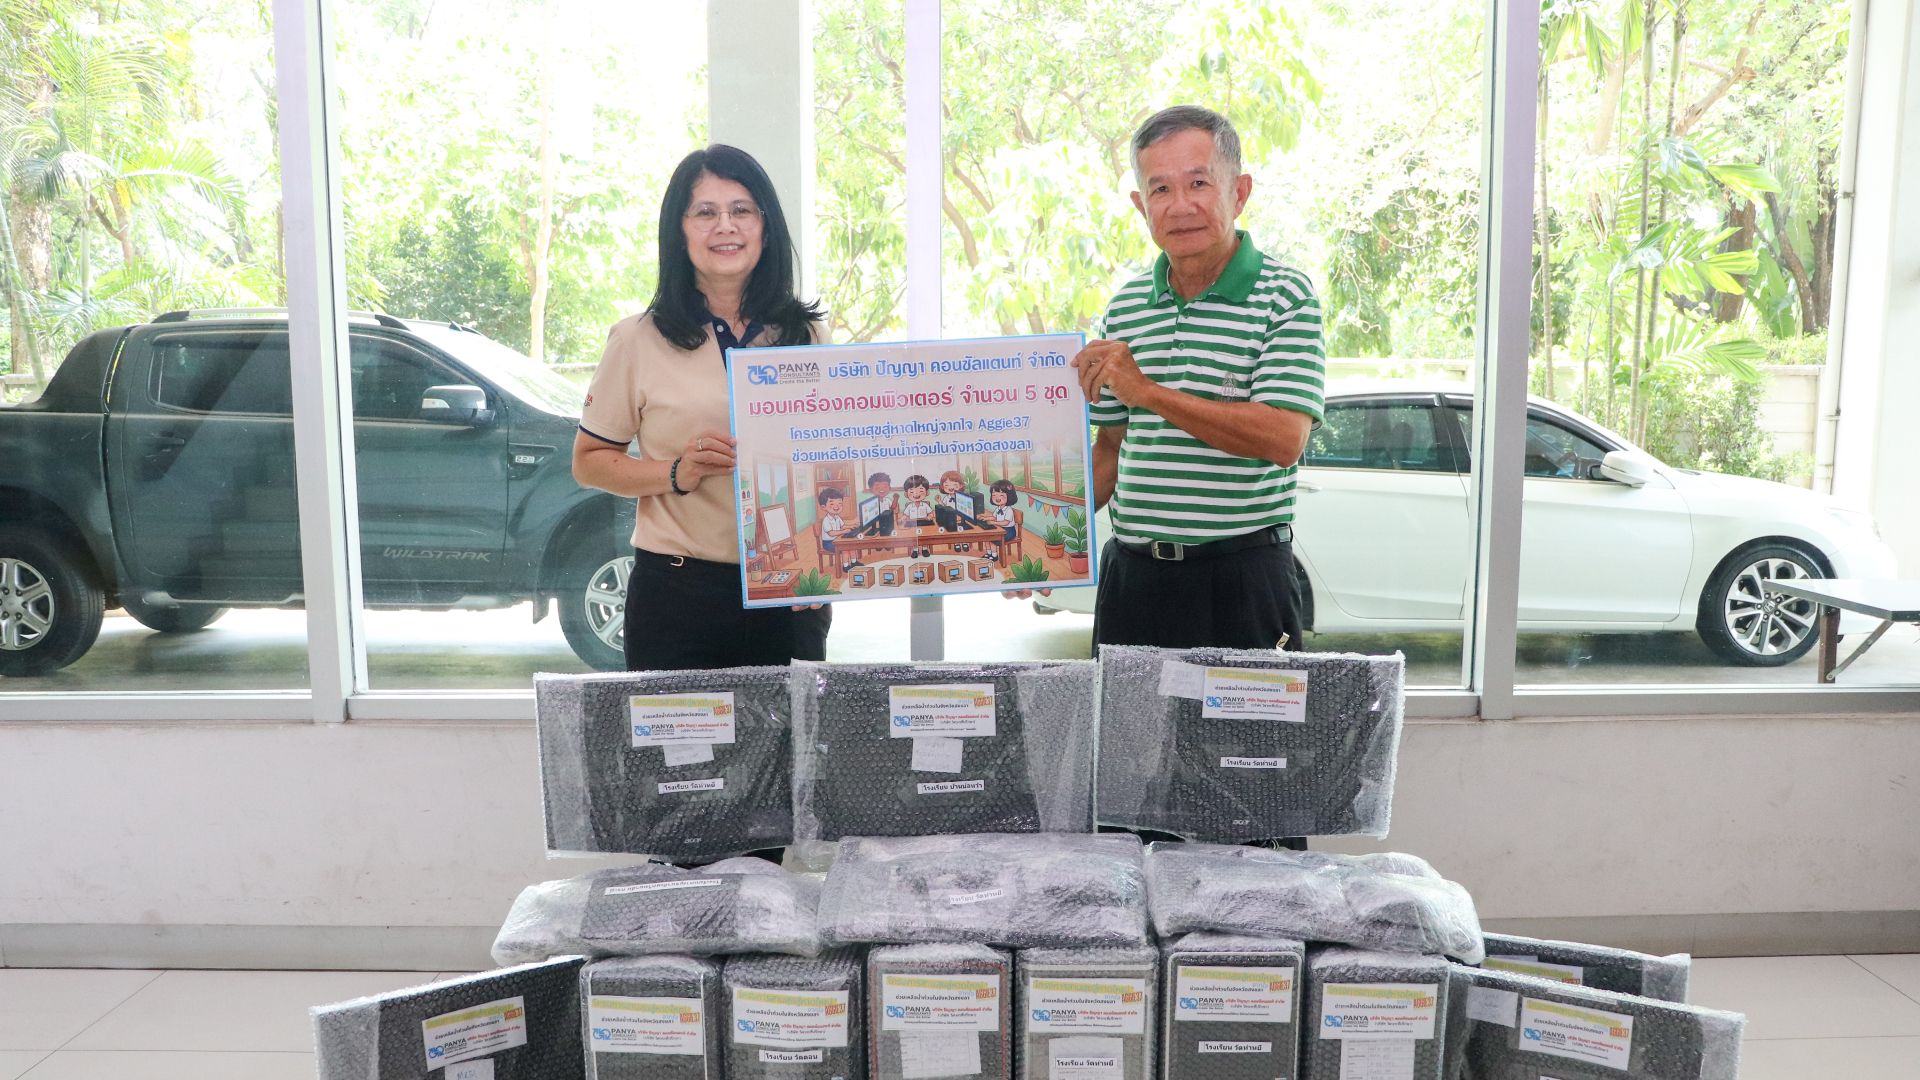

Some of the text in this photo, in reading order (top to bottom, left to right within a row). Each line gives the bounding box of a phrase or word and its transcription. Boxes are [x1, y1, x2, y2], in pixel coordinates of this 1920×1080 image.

[779, 363, 820, 373] PANYA
[828, 351, 1066, 378] บริษัท ปัญญา คอนซัลแตนท์ จำกัด
[750, 384, 1068, 415] มอบเครื่องคอมพิวเตอร์ จำนวน 5 ชุด
[790, 416, 1030, 440] โครงการสานสุขสู่หาดใหญ่จากใจ Aggie37
[792, 439, 1031, 462] ช่วยเหลือโรงเรียนน้ำท่วมในจังหวัดสงขลา
[383, 547, 490, 562] WILDTRAK
[1270, 980, 1290, 991] AGGIE37
[1542, 1030, 1566, 1039] PANYA
[444, 1038, 466, 1048] PANYA
